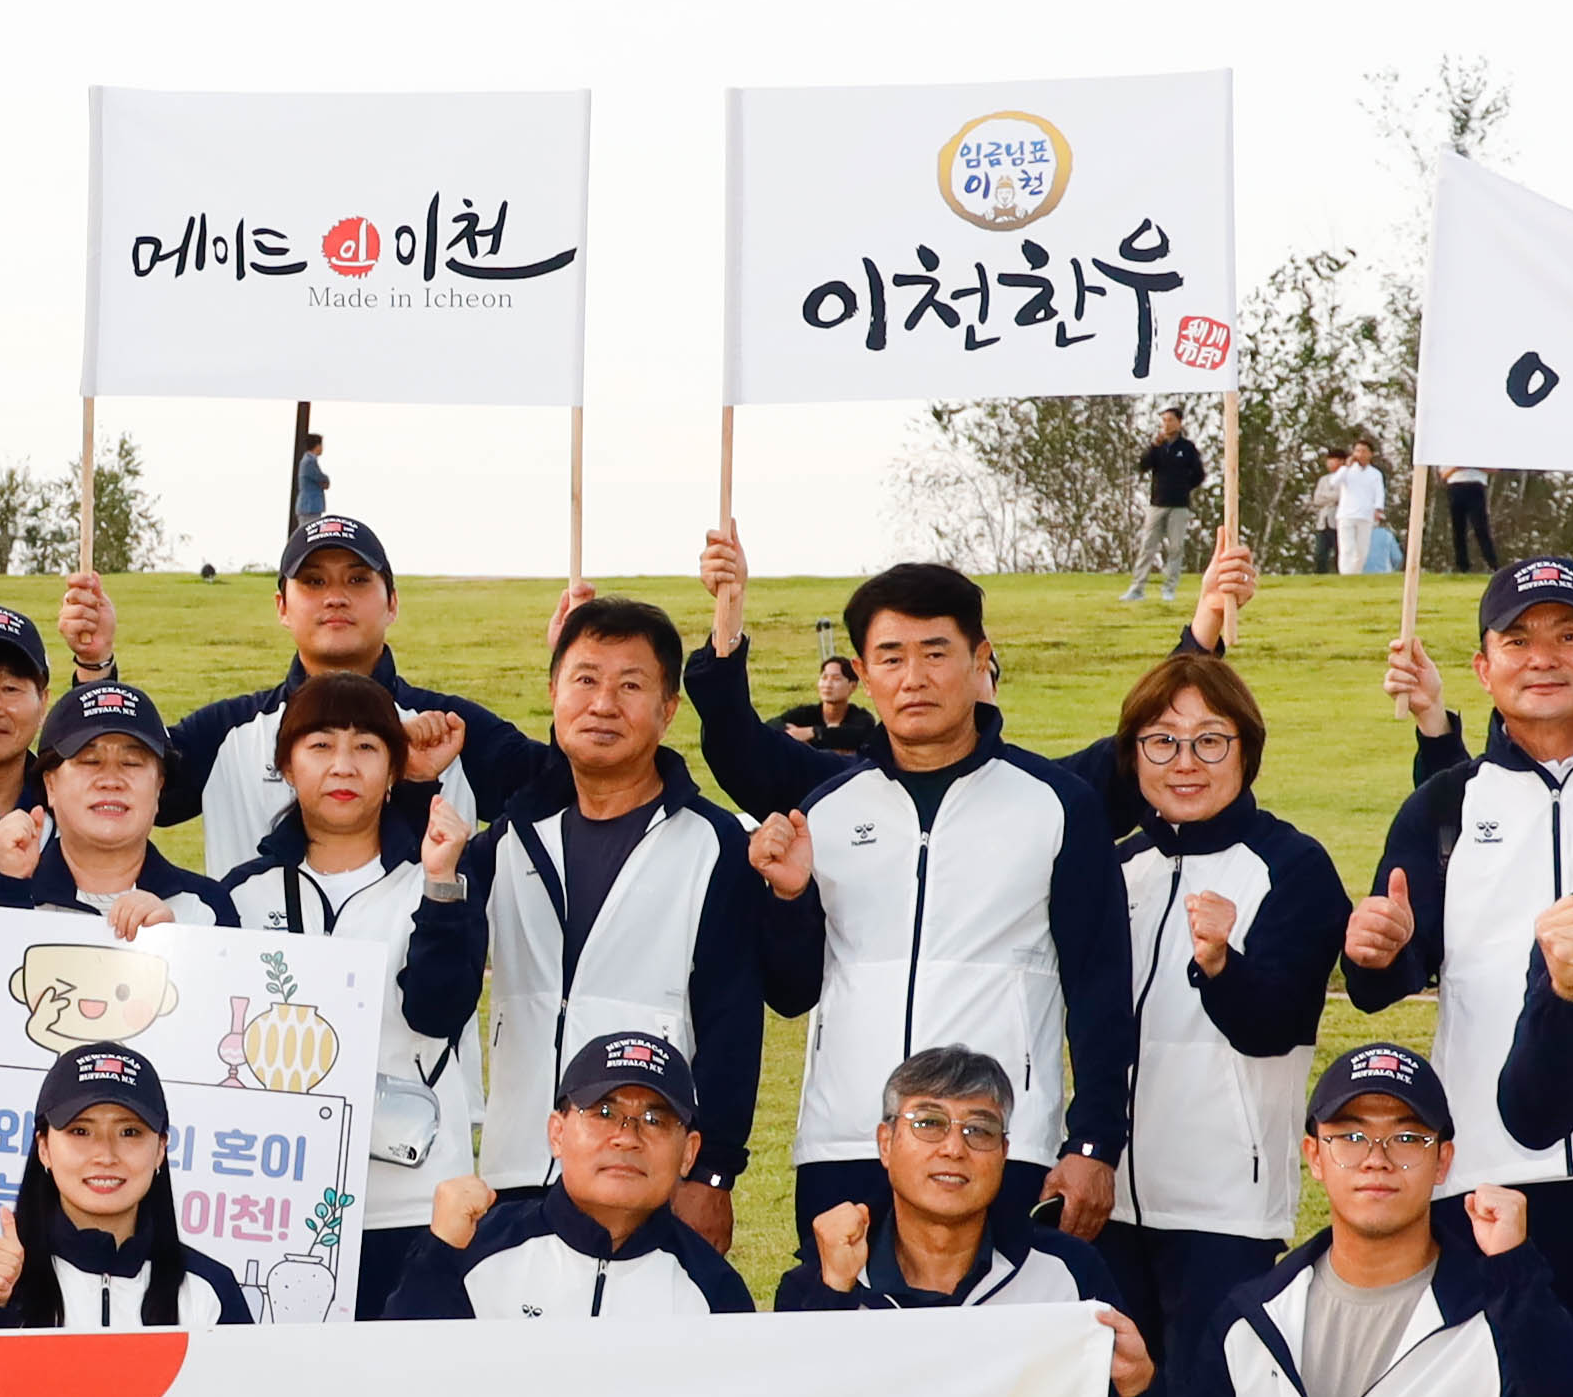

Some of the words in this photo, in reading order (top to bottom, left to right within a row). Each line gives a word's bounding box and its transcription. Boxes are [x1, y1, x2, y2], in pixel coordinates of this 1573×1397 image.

[959, 139, 1050, 169] 임금님표
[964, 169, 1044, 199] 이천
[132, 212, 308, 281] 메이드
[327, 217, 378, 270] 인
[395, 191, 577, 282] 이천
[308, 287, 379, 308] Made
[390, 288, 413, 308] in
[424, 288, 513, 309] Icheon
[802, 218, 1184, 379] 이천한우
[212, 1129, 306, 1181] 혼이
[181, 1191, 291, 1243] 이천!
